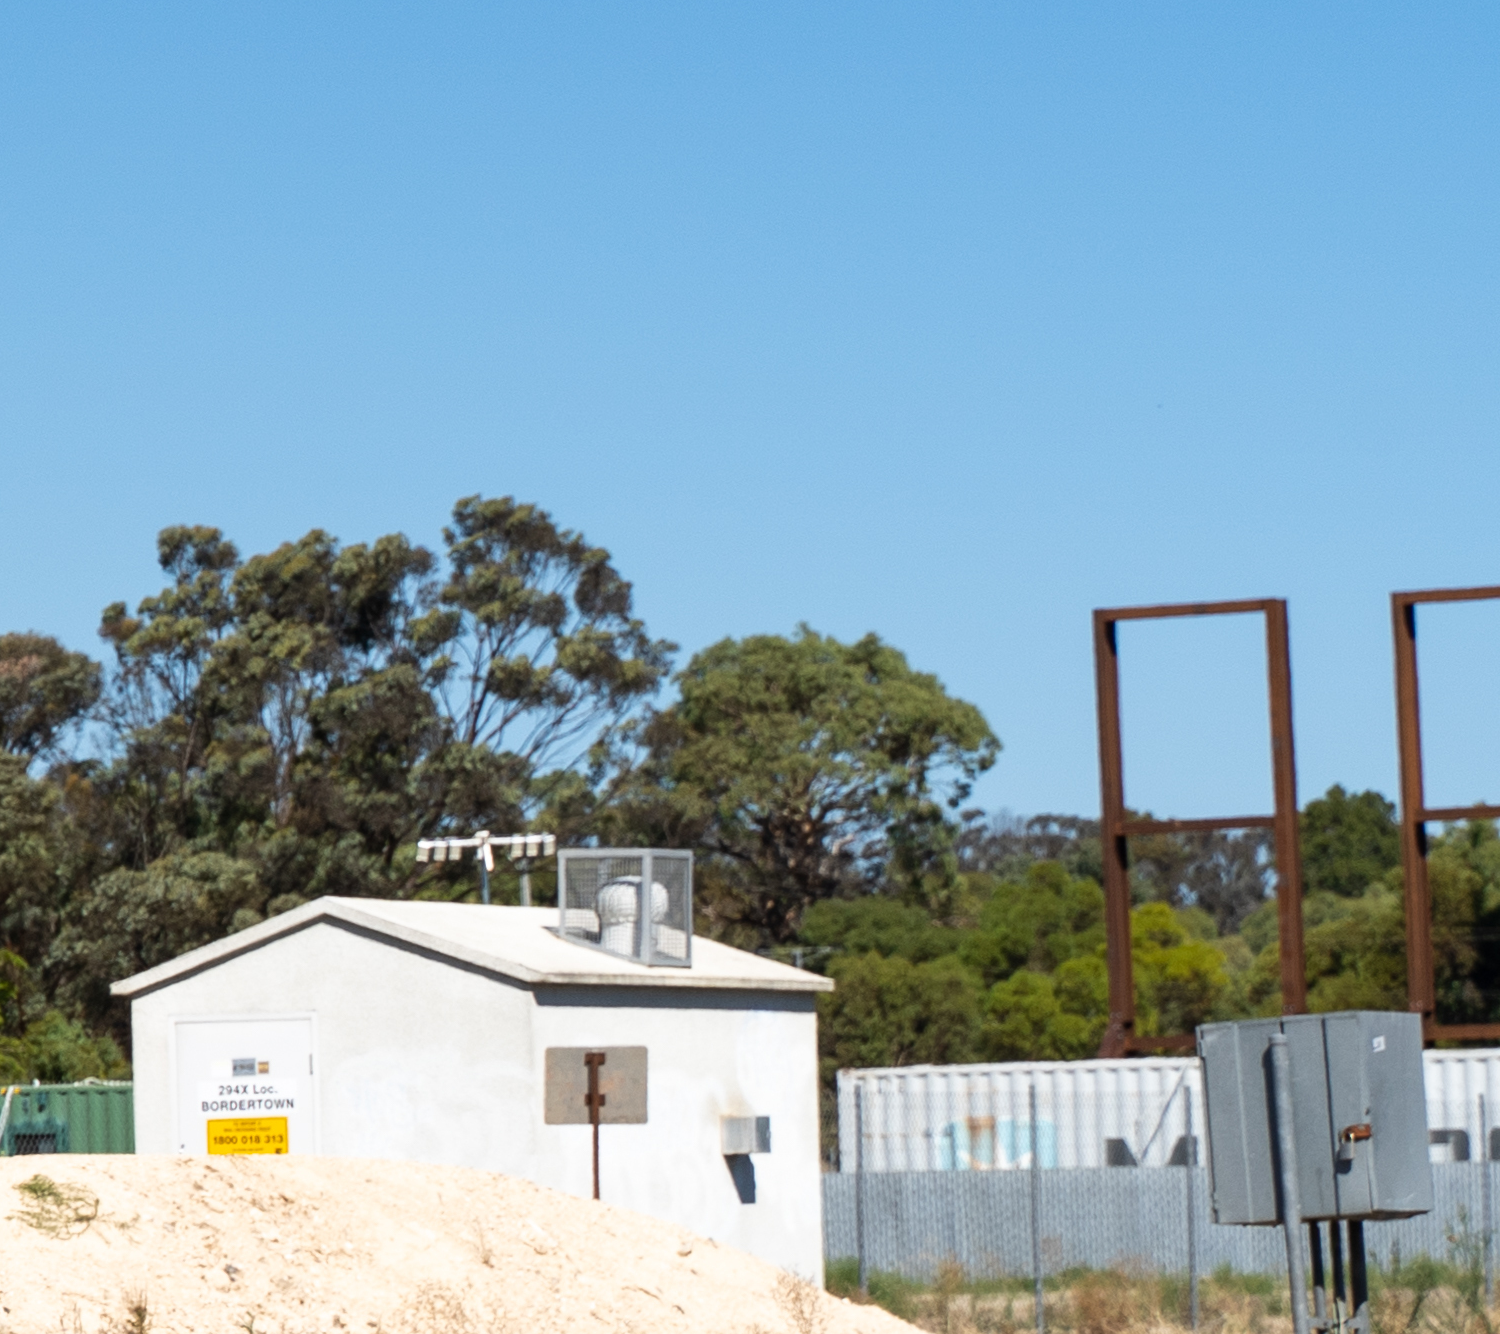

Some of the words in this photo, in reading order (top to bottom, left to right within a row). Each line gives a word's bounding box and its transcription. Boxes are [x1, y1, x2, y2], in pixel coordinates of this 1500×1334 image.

[218, 1085, 248, 1096] 294X
[253, 1084, 278, 1095] Loc.
[201, 1098, 294, 1112] BORDERTOWN
[213, 1135, 238, 1145] 1800
[241, 1135, 260, 1145] 018
[264, 1134, 284, 1144] 313
